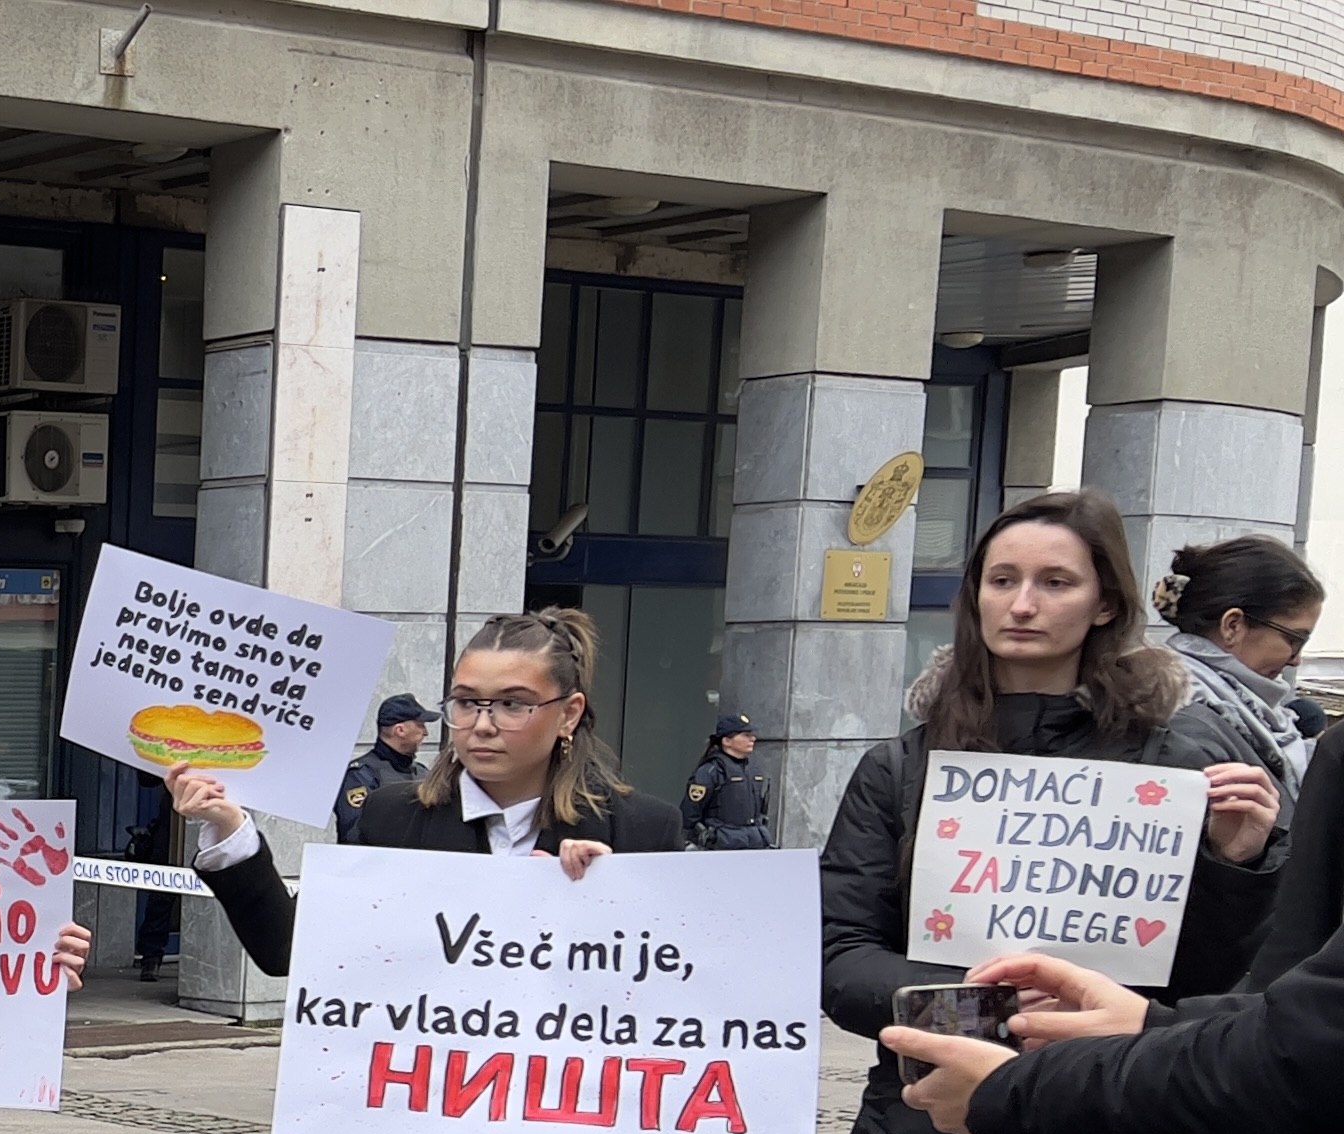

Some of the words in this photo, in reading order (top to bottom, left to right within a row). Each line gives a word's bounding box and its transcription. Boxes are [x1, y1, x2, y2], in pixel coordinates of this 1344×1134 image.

[115, 606, 227, 652] pravimo
[234, 641, 323, 678] snove
[134, 580, 201, 619] Bolje
[209, 609, 278, 641] ovde
[286, 624, 323, 651] da
[89, 642, 184, 693] jedemo
[193, 683, 315, 731] sendviče
[118, 632, 181, 666] nego
[191, 651, 259, 688] tamo
[270, 676, 307, 701] da
[105, 865, 139, 883] STOP
[143, 869, 203, 891] POLICIJA
[1144, 873, 1185, 902] UZ
[434, 911, 552, 971] Všeč
[567, 931, 625, 973] mi
[633, 931, 695, 983] je,
[985, 903, 1132, 945] KOLEGE
[295, 987, 370, 1028] kar
[385, 994, 521, 1039] vlada
[535, 1003, 638, 1046] dela
[653, 1017, 705, 1049] za
[722, 1017, 808, 1052] nas
[367, 1041, 748, 1134] НИШТА
